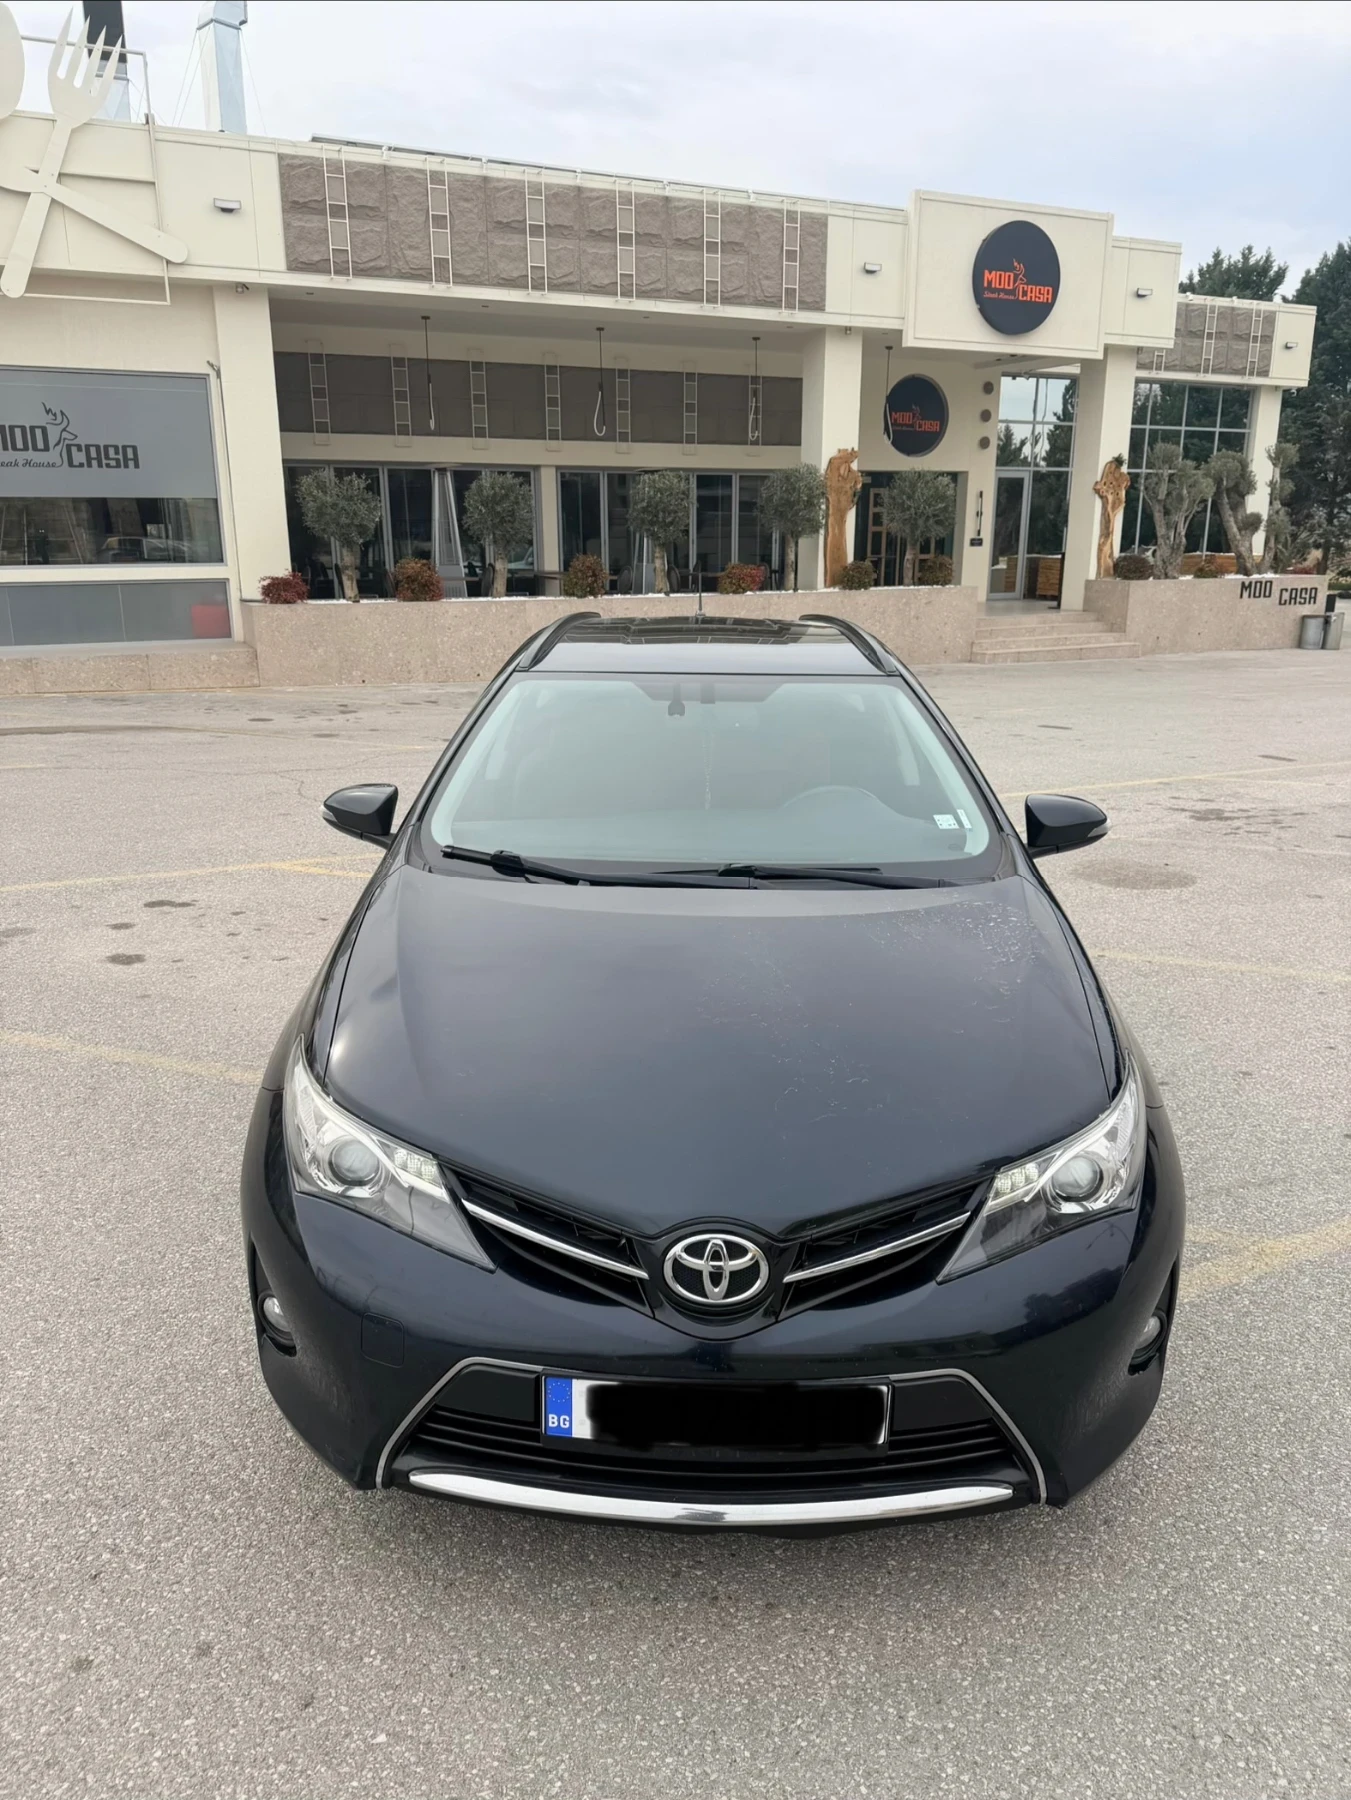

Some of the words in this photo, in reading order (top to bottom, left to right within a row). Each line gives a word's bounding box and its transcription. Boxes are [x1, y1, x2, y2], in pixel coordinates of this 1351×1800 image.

[984, 269, 1014, 289] MOO
[1019, 284, 1053, 303] CASA
[21, 458, 57, 468] House
[65, 443, 140, 469] CASA
[1240, 580, 1273, 599] MOO
[1278, 587, 1318, 606] CASA
[548, 1413, 570, 1428] BG
